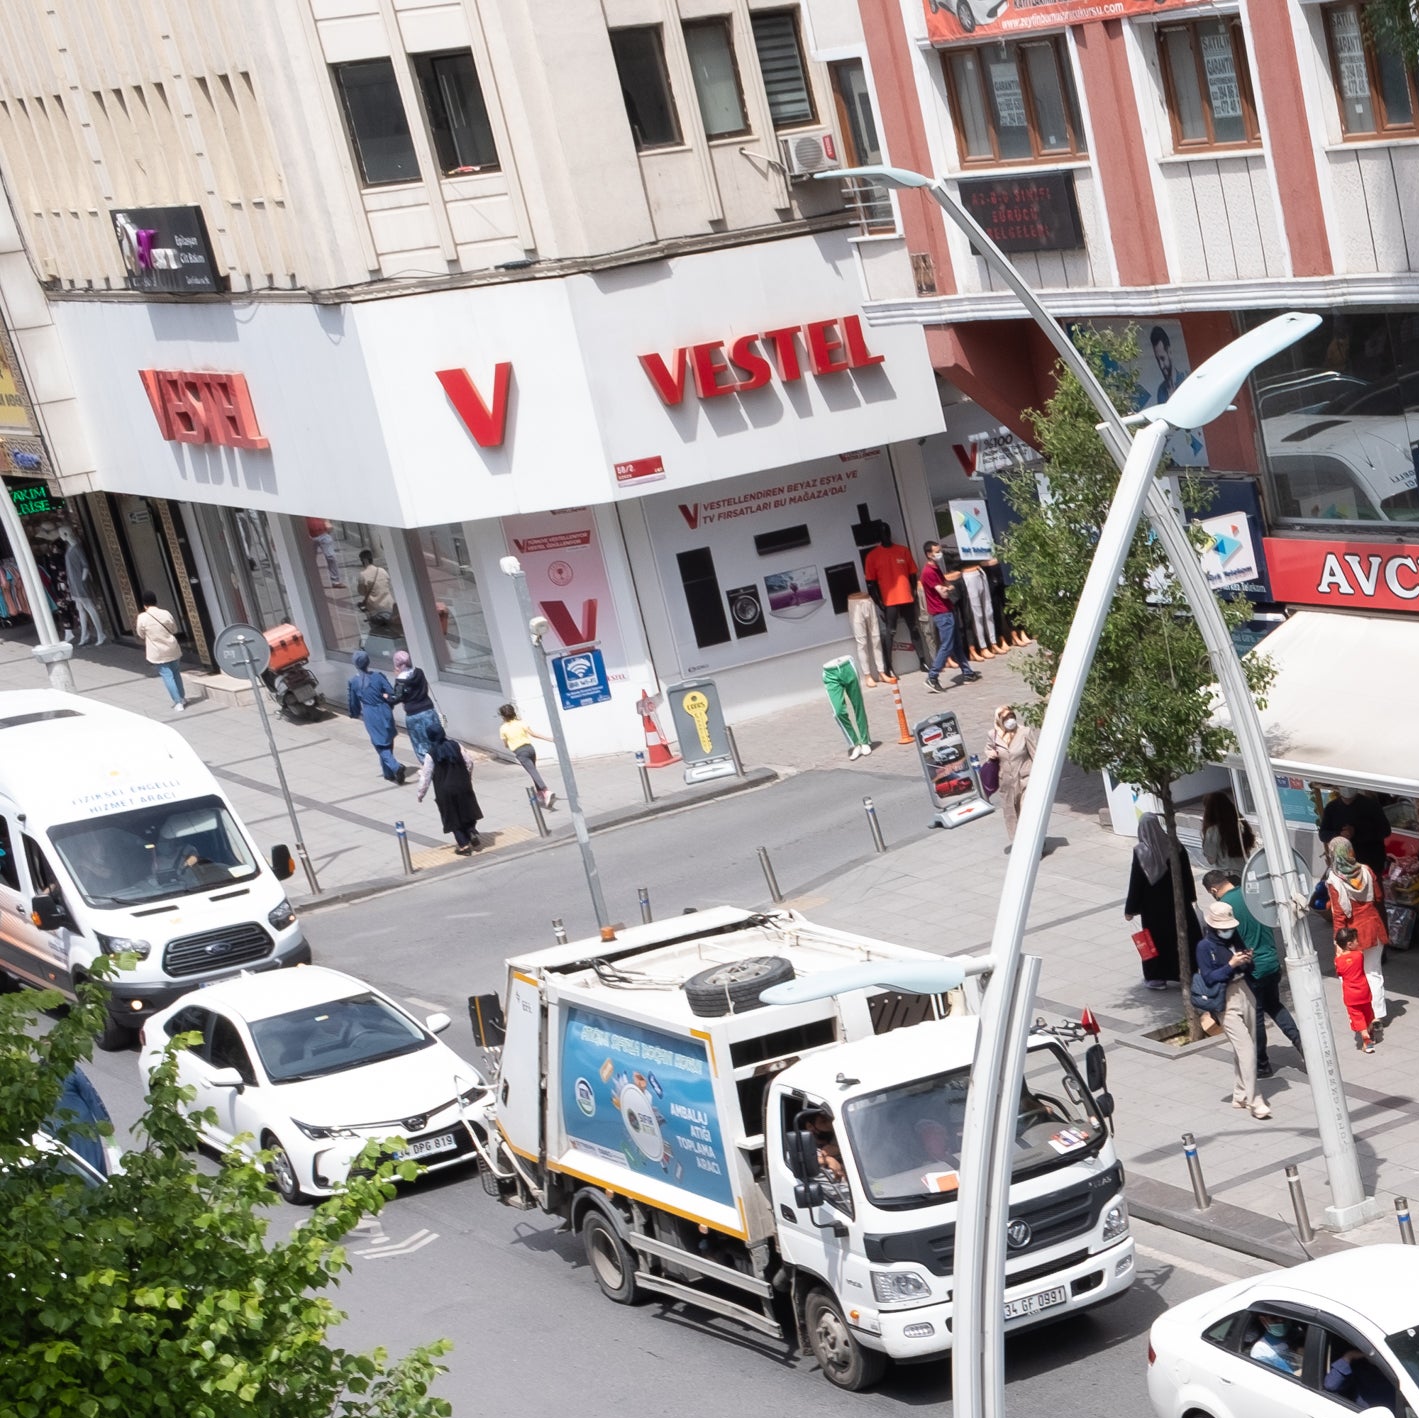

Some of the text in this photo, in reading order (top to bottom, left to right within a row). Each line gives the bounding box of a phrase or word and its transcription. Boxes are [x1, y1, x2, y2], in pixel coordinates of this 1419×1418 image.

[637, 314, 886, 406] VESTEL
[138, 369, 270, 449] VESTEL
[435, 361, 512, 448] V
[703, 469, 858, 512] VESTELLENDİREN BEYAZ EŞYA VE
[703, 514, 715, 525] TV
[717, 502, 772, 523] FIRSATLARI
[773, 498, 787, 508] BU
[788, 484, 847, 507] MAĞAZA'DA!
[670, 1103, 709, 1126] AMBALAJ
[413, 1142, 432, 1155] DPG
[434, 1136, 452, 1149] 819
[676, 1135, 717, 1159] TOPLAMA
[697, 1158, 722, 1175] ARACI
[1005, 1286, 1065, 1317] 34 GF 0991
